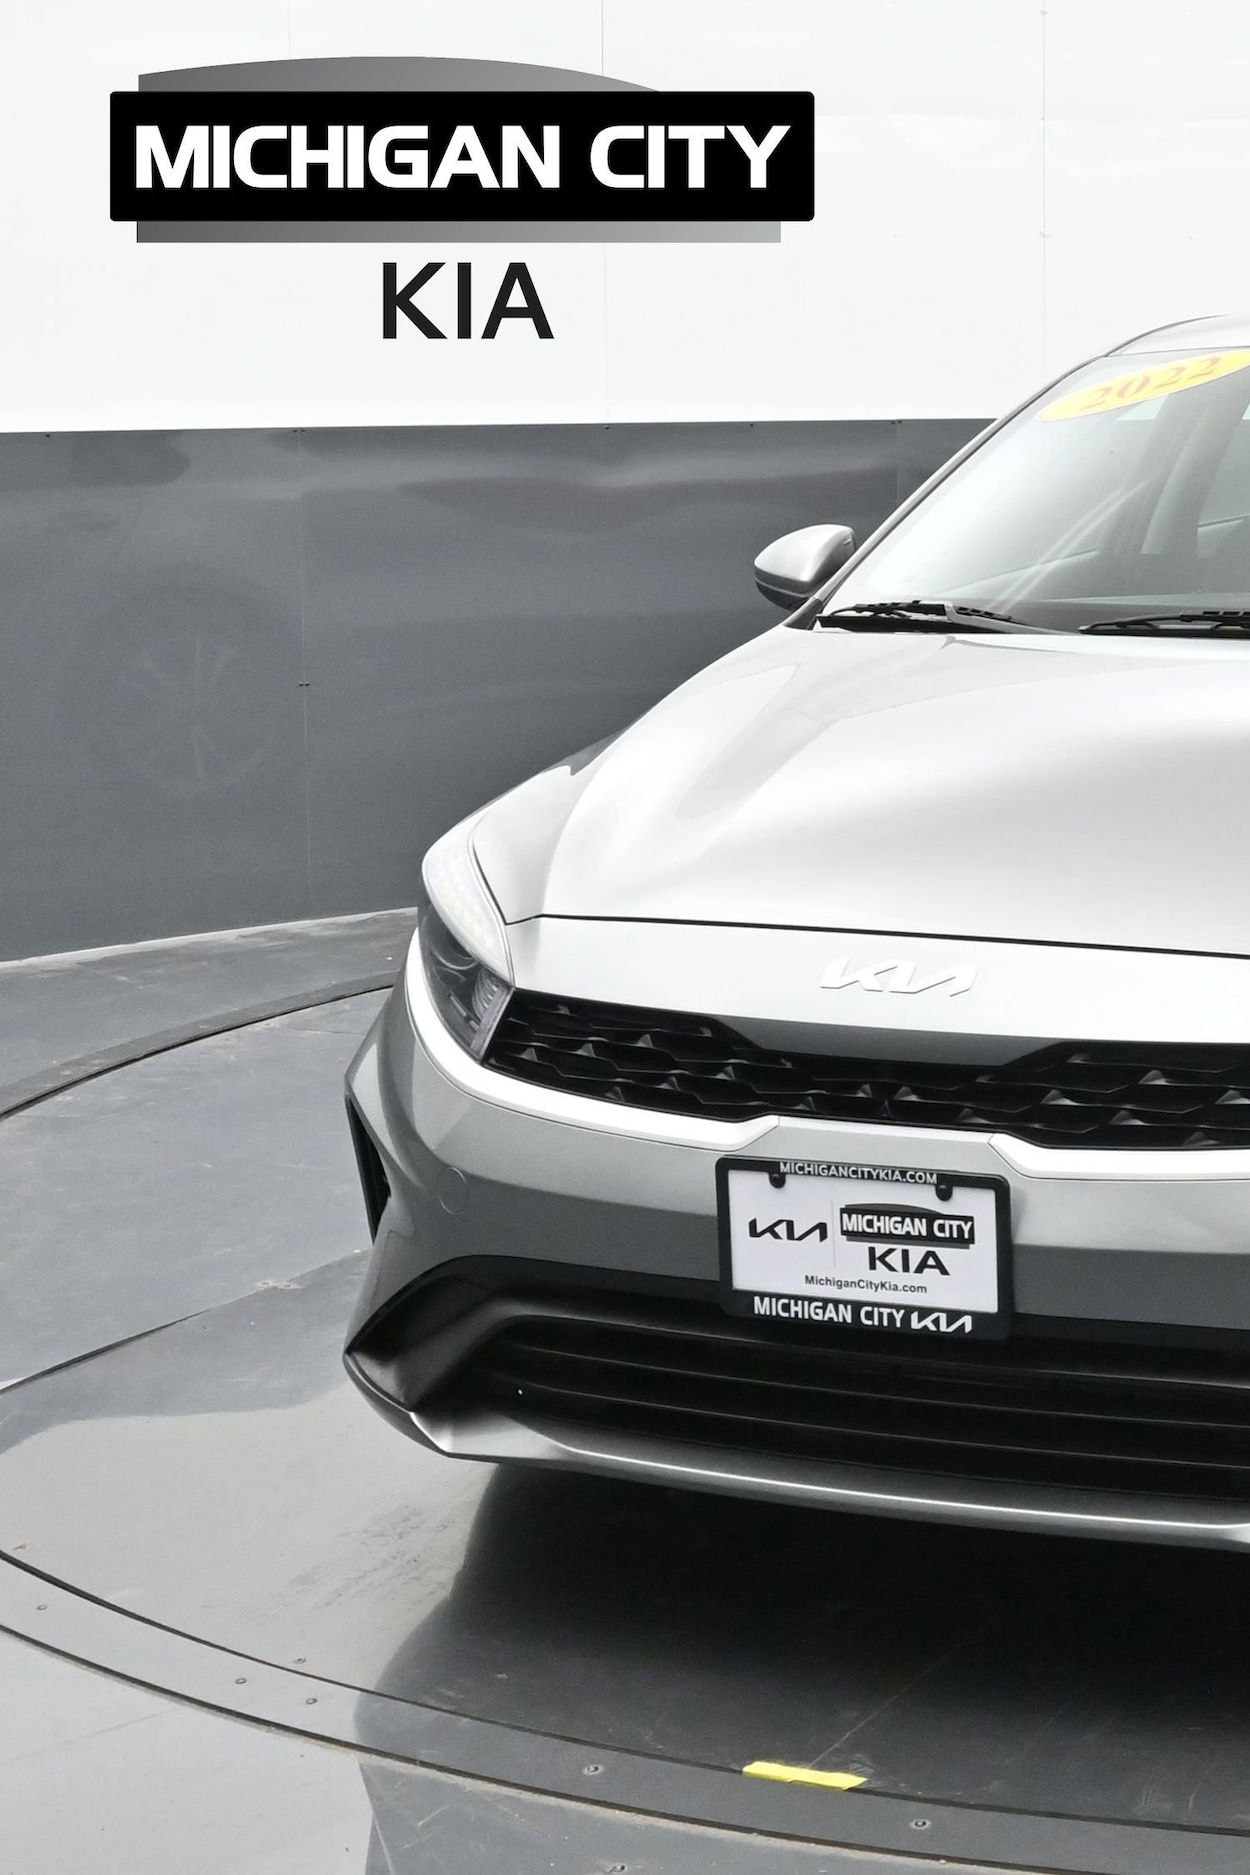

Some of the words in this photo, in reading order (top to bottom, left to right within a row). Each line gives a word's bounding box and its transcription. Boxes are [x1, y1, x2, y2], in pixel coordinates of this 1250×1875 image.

[1078, 356, 1222, 412] 2022
[779, 1161, 938, 1185] MICHIGANCITYKIA.COM
[748, 1217, 828, 1243] KIA
[841, 1212, 928, 1237] MICHIGAN
[932, 1218, 973, 1240] CITY
[867, 1246, 951, 1276] KIA
[804, 1274, 928, 1295] MichiganCityKia.com
[753, 1295, 853, 1324] MICHIGAN
[859, 1305, 906, 1328] CITY
[910, 1311, 973, 1334] KIA
